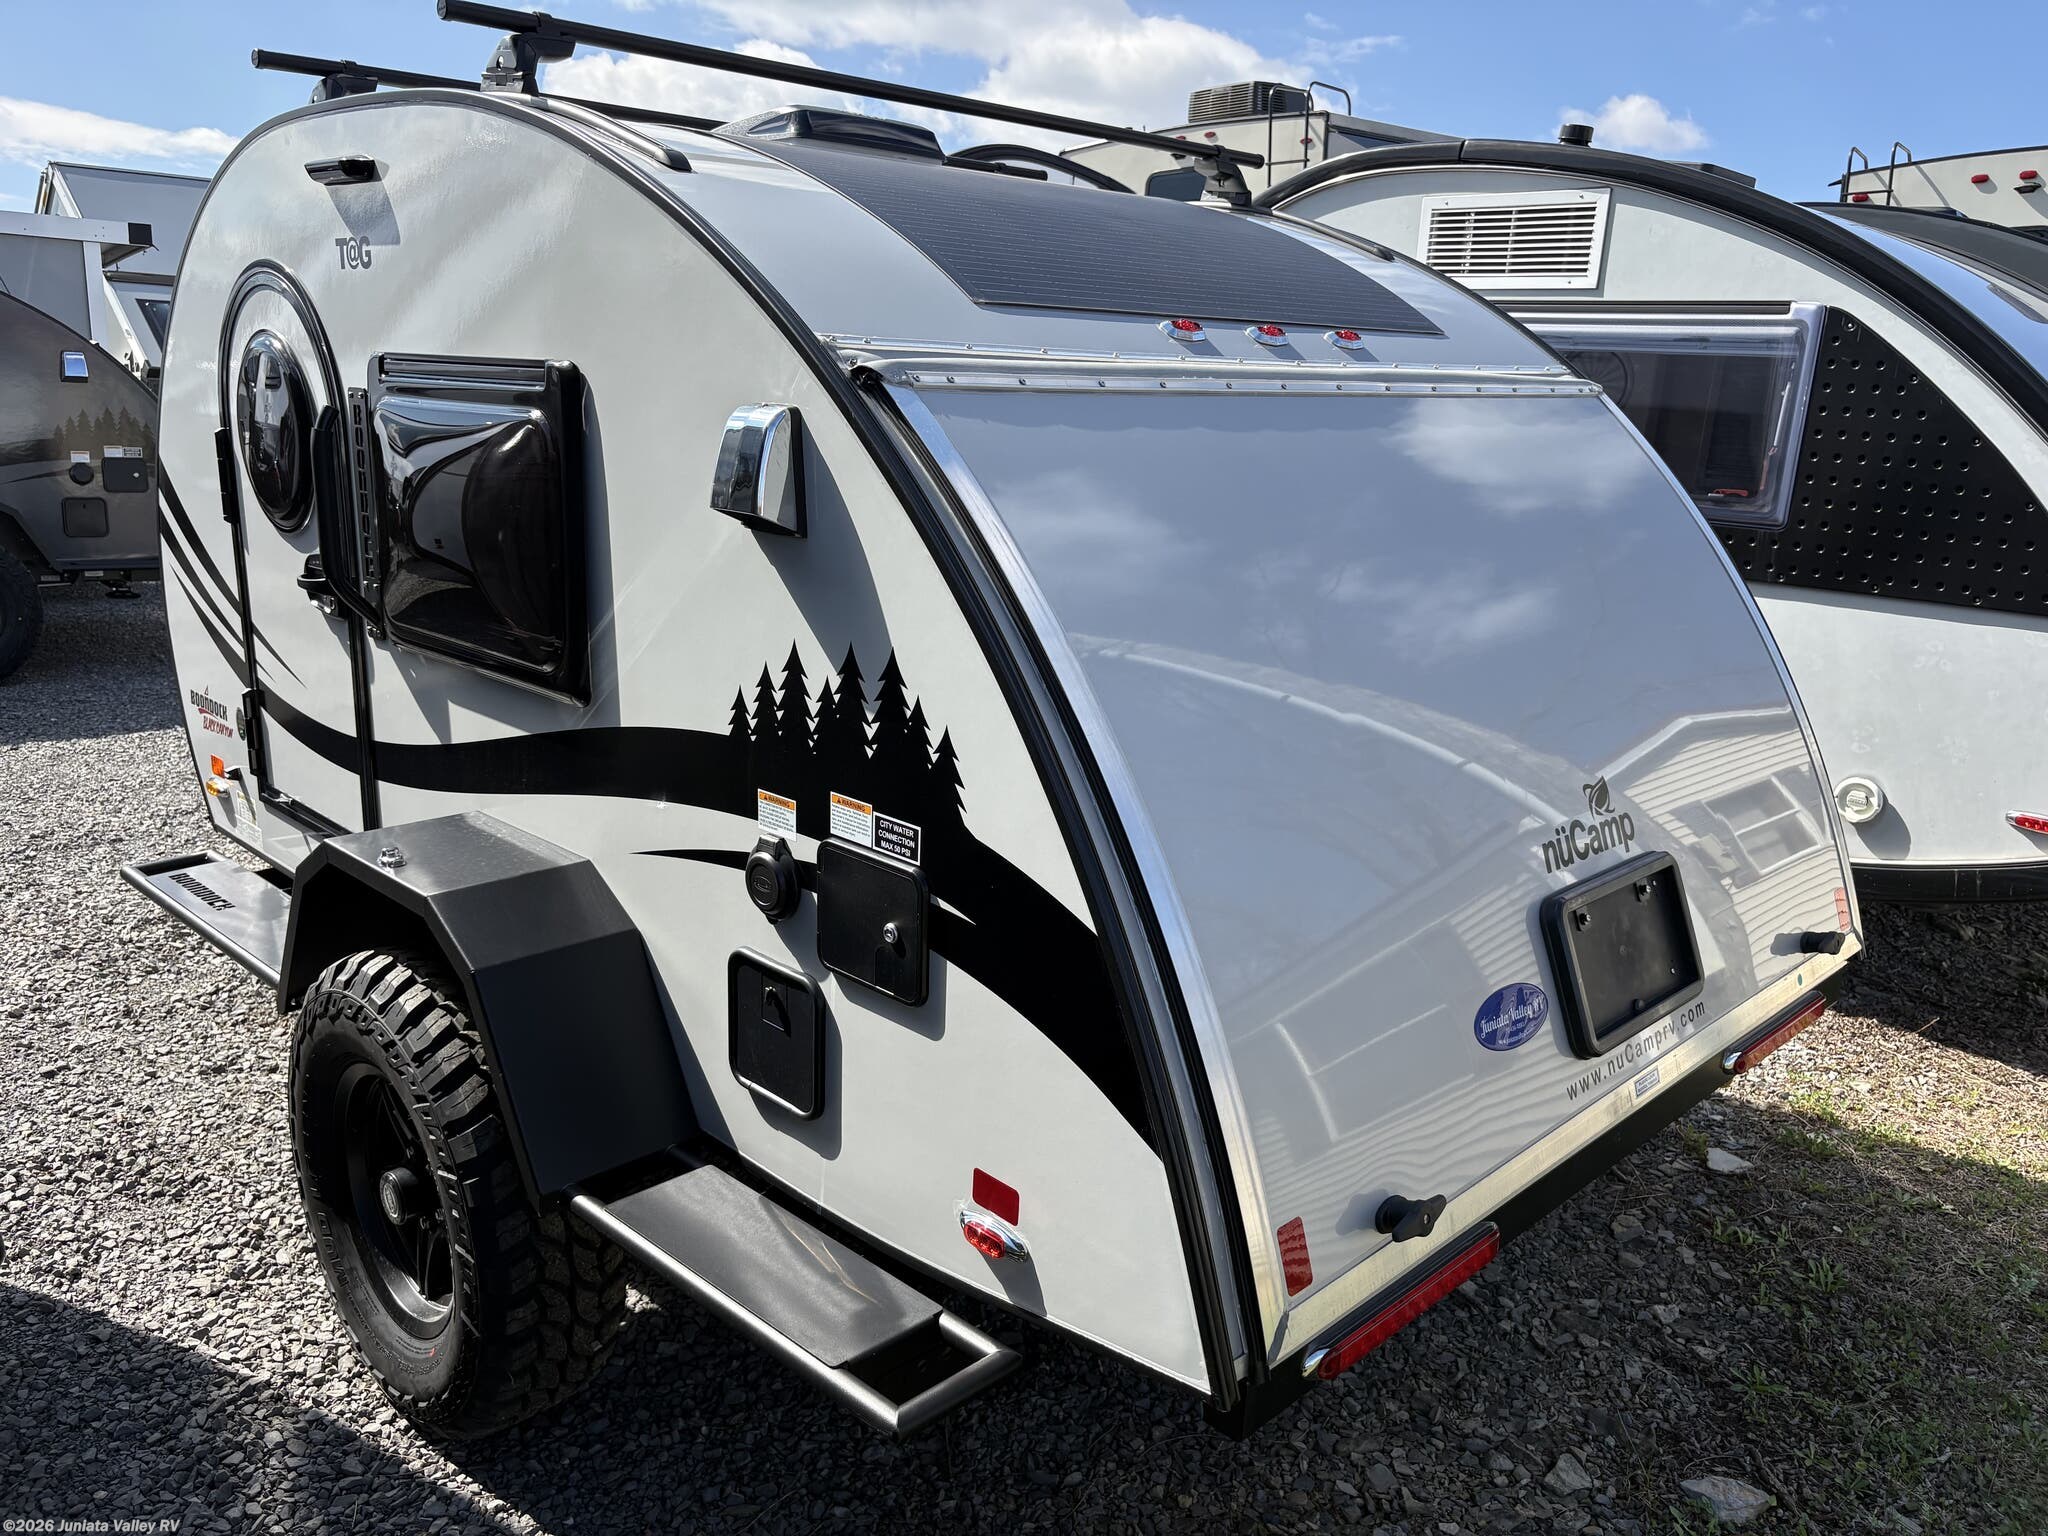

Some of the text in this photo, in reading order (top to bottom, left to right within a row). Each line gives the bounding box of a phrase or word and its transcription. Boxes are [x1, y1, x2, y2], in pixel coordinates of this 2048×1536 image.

[335, 235, 373, 270] T@G
[190, 689, 228, 721] BOONDOCK
[768, 795, 790, 808] WARNING
[841, 799, 866, 812] WARNING
[878, 829, 915, 849] CONNECTION
[880, 820, 914, 838] CITY WATER
[1542, 811, 1635, 874] nüCamp
[880, 840, 911, 857] MAX 50 PSI
[168, 872, 236, 912] BOONDOCK
[1480, 1014, 1510, 1039] Juniata
[1509, 1003, 1533, 1021] Valley
[1566, 1001, 1706, 1100] www.nuCamprv.com
